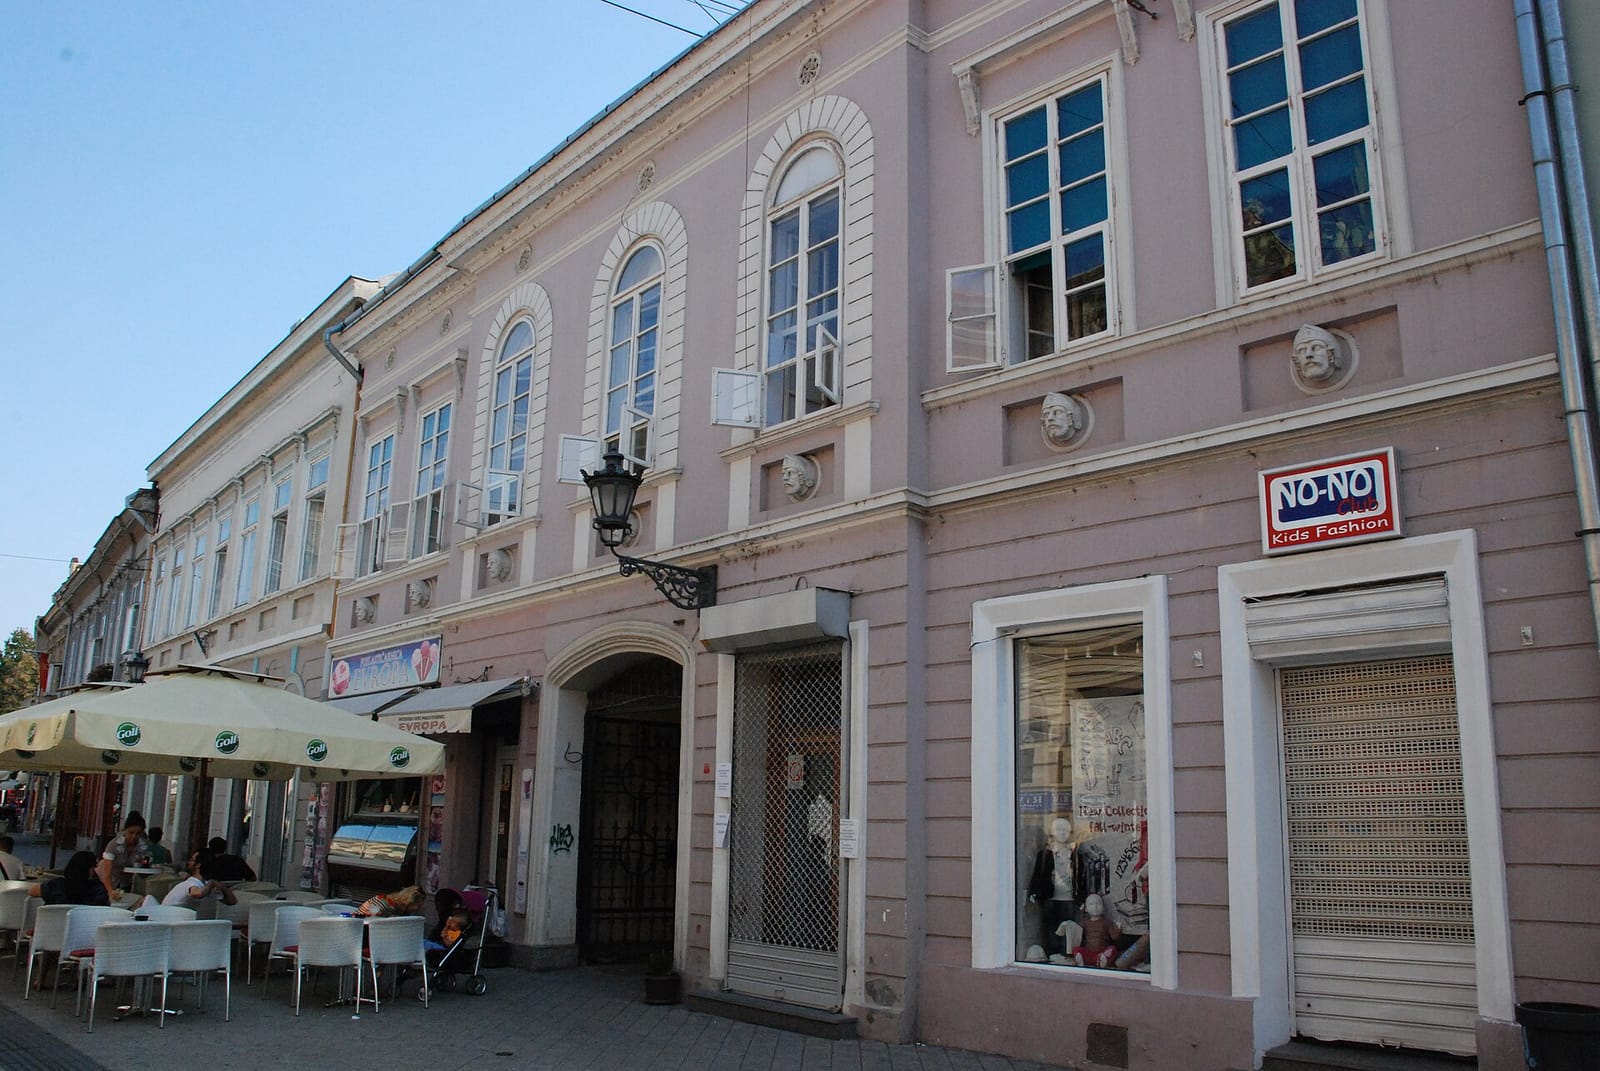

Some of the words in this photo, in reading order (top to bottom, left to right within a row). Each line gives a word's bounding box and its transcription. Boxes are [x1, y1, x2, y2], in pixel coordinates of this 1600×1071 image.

[1279, 467, 1373, 510] NO-NO
[1336, 495, 1378, 516] Club
[1272, 530, 1310, 545] Kids
[1316, 517, 1389, 538] Fashion
[399, 720, 448, 731] EVROPA
[1104, 727, 1134, 755] ABC
